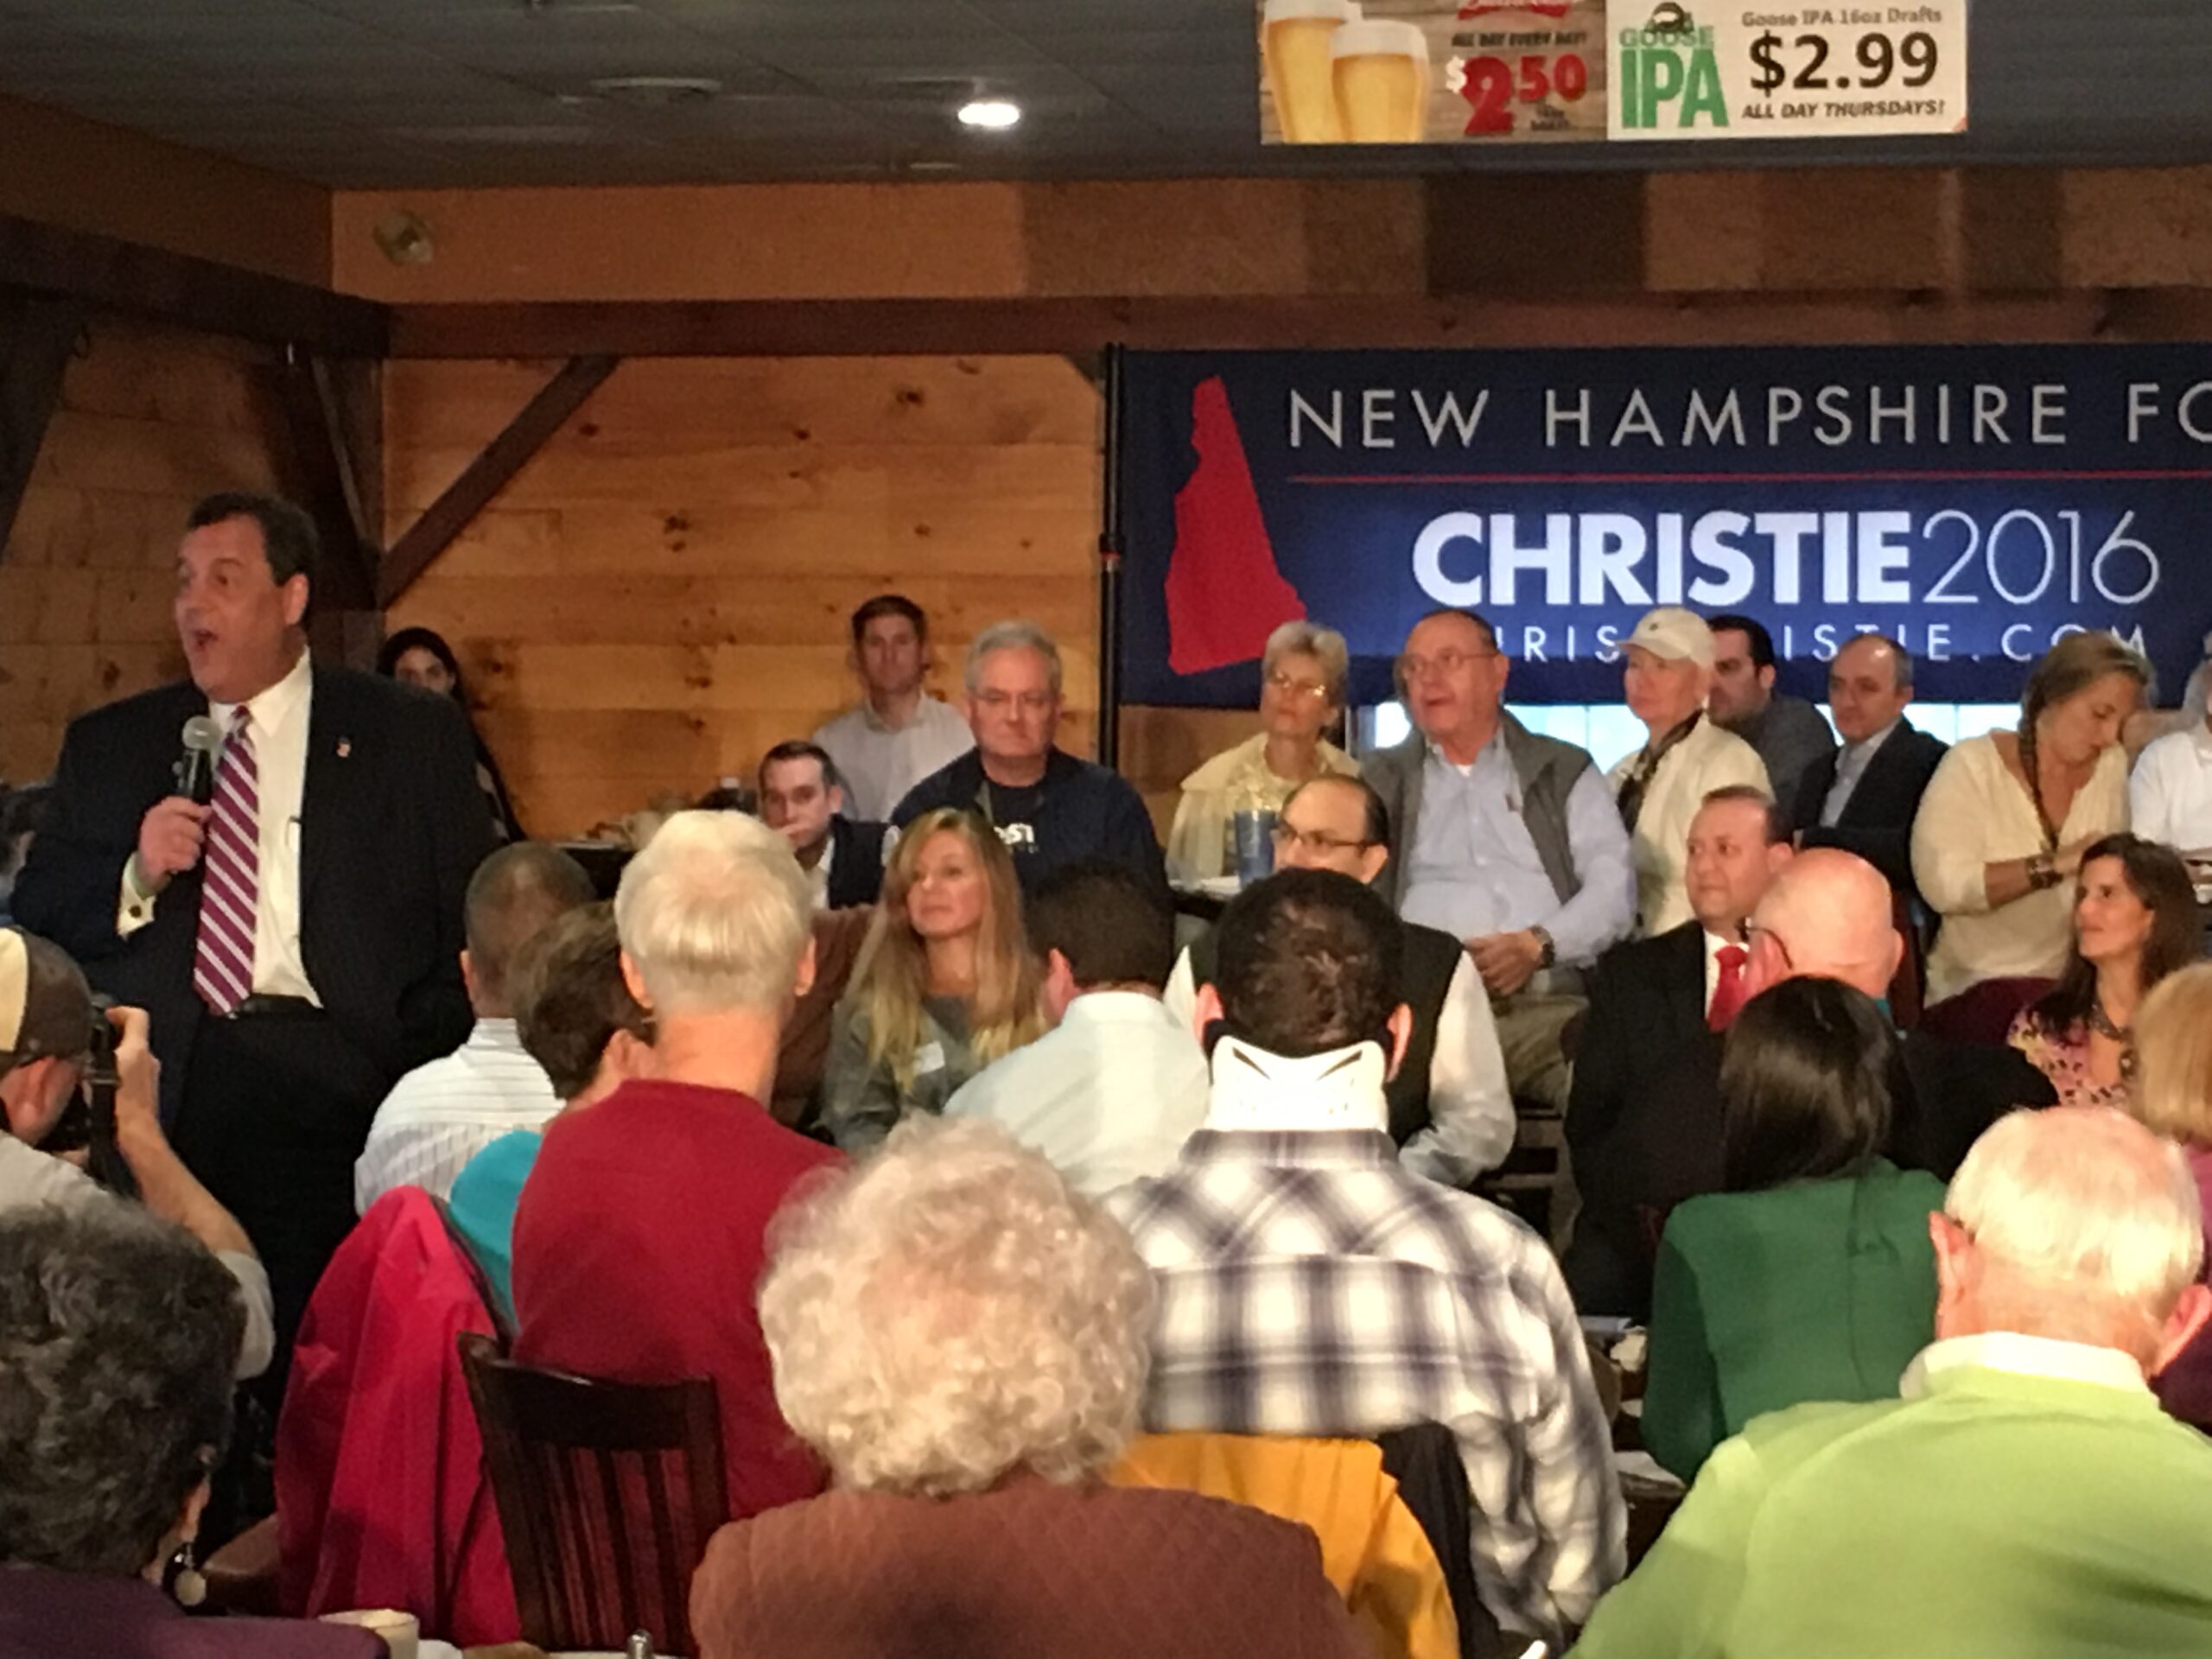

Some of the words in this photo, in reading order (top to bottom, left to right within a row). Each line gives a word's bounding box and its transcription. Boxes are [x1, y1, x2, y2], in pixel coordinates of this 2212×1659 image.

[1619, 26, 1714, 48] GOOSE
[1742, 12, 1797, 27] Goose
[1802, 10, 1834, 24] IPA
[1840, 10, 1881, 24] 16oz
[1887, 6, 1942, 23] Drafts
[1750, 29, 1938, 98] $2.99
[1621, 48, 1730, 128] IPA
[1742, 104, 1774, 118] ALL
[1781, 103, 1818, 118] DAY
[1825, 99, 1946, 117] THURSDAYS!
[1290, 389, 1490, 448] NEW
[1544, 385, 2068, 448] HAMPSHIRE
